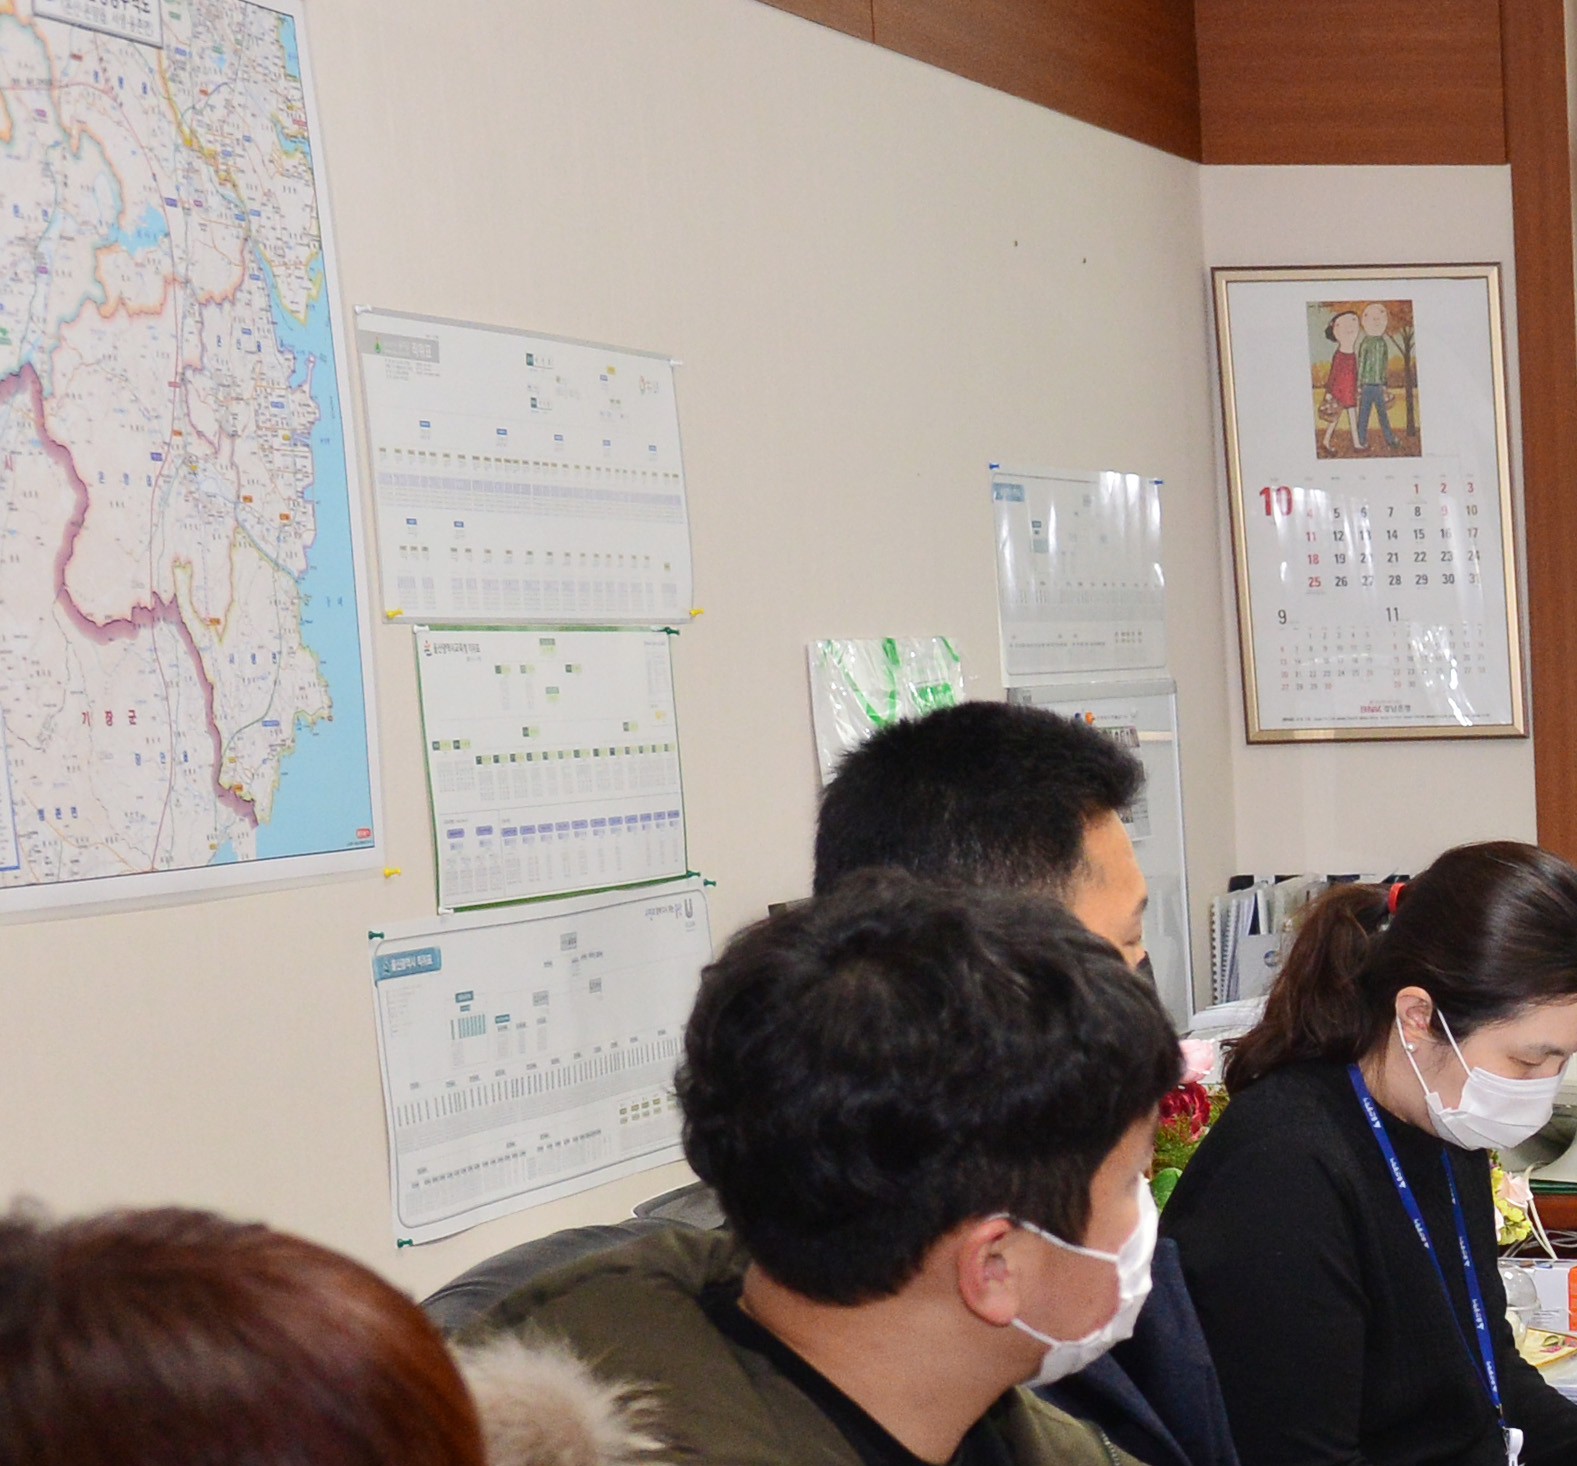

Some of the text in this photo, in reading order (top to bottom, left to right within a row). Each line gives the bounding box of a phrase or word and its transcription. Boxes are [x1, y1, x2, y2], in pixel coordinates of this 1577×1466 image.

[1414, 482, 1474, 494] 1 2 3
[1259, 486, 1293, 517] 10
[1333, 508, 1340, 519] 5
[1361, 506, 1367, 518] 6
[1389, 507, 1393, 517] 7
[1415, 506, 1421, 517] 8
[1466, 505, 1478, 516] 10
[1306, 531, 1316, 542] 11
[1333, 531, 1344, 541] 12
[1387, 530, 1398, 540] 14
[1414, 529, 1425, 539] 15
[1440, 528, 1451, 539] 16
[1468, 527, 1478, 538] 17
[1308, 554, 1319, 565] 18
[1334, 553, 1345, 564] 19
[1387, 552, 1398, 563] 21
[1414, 551, 1426, 562] 22
[1441, 551, 1453, 562] 23
[1468, 550, 1480, 561] 24
[1309, 577, 1321, 588] 25
[1335, 576, 1347, 587] 26
[1389, 575, 1401, 586] 28
[1416, 574, 1428, 585] 29
[1442, 573, 1455, 584] 30
[1278, 607, 1399, 625] 9 11
